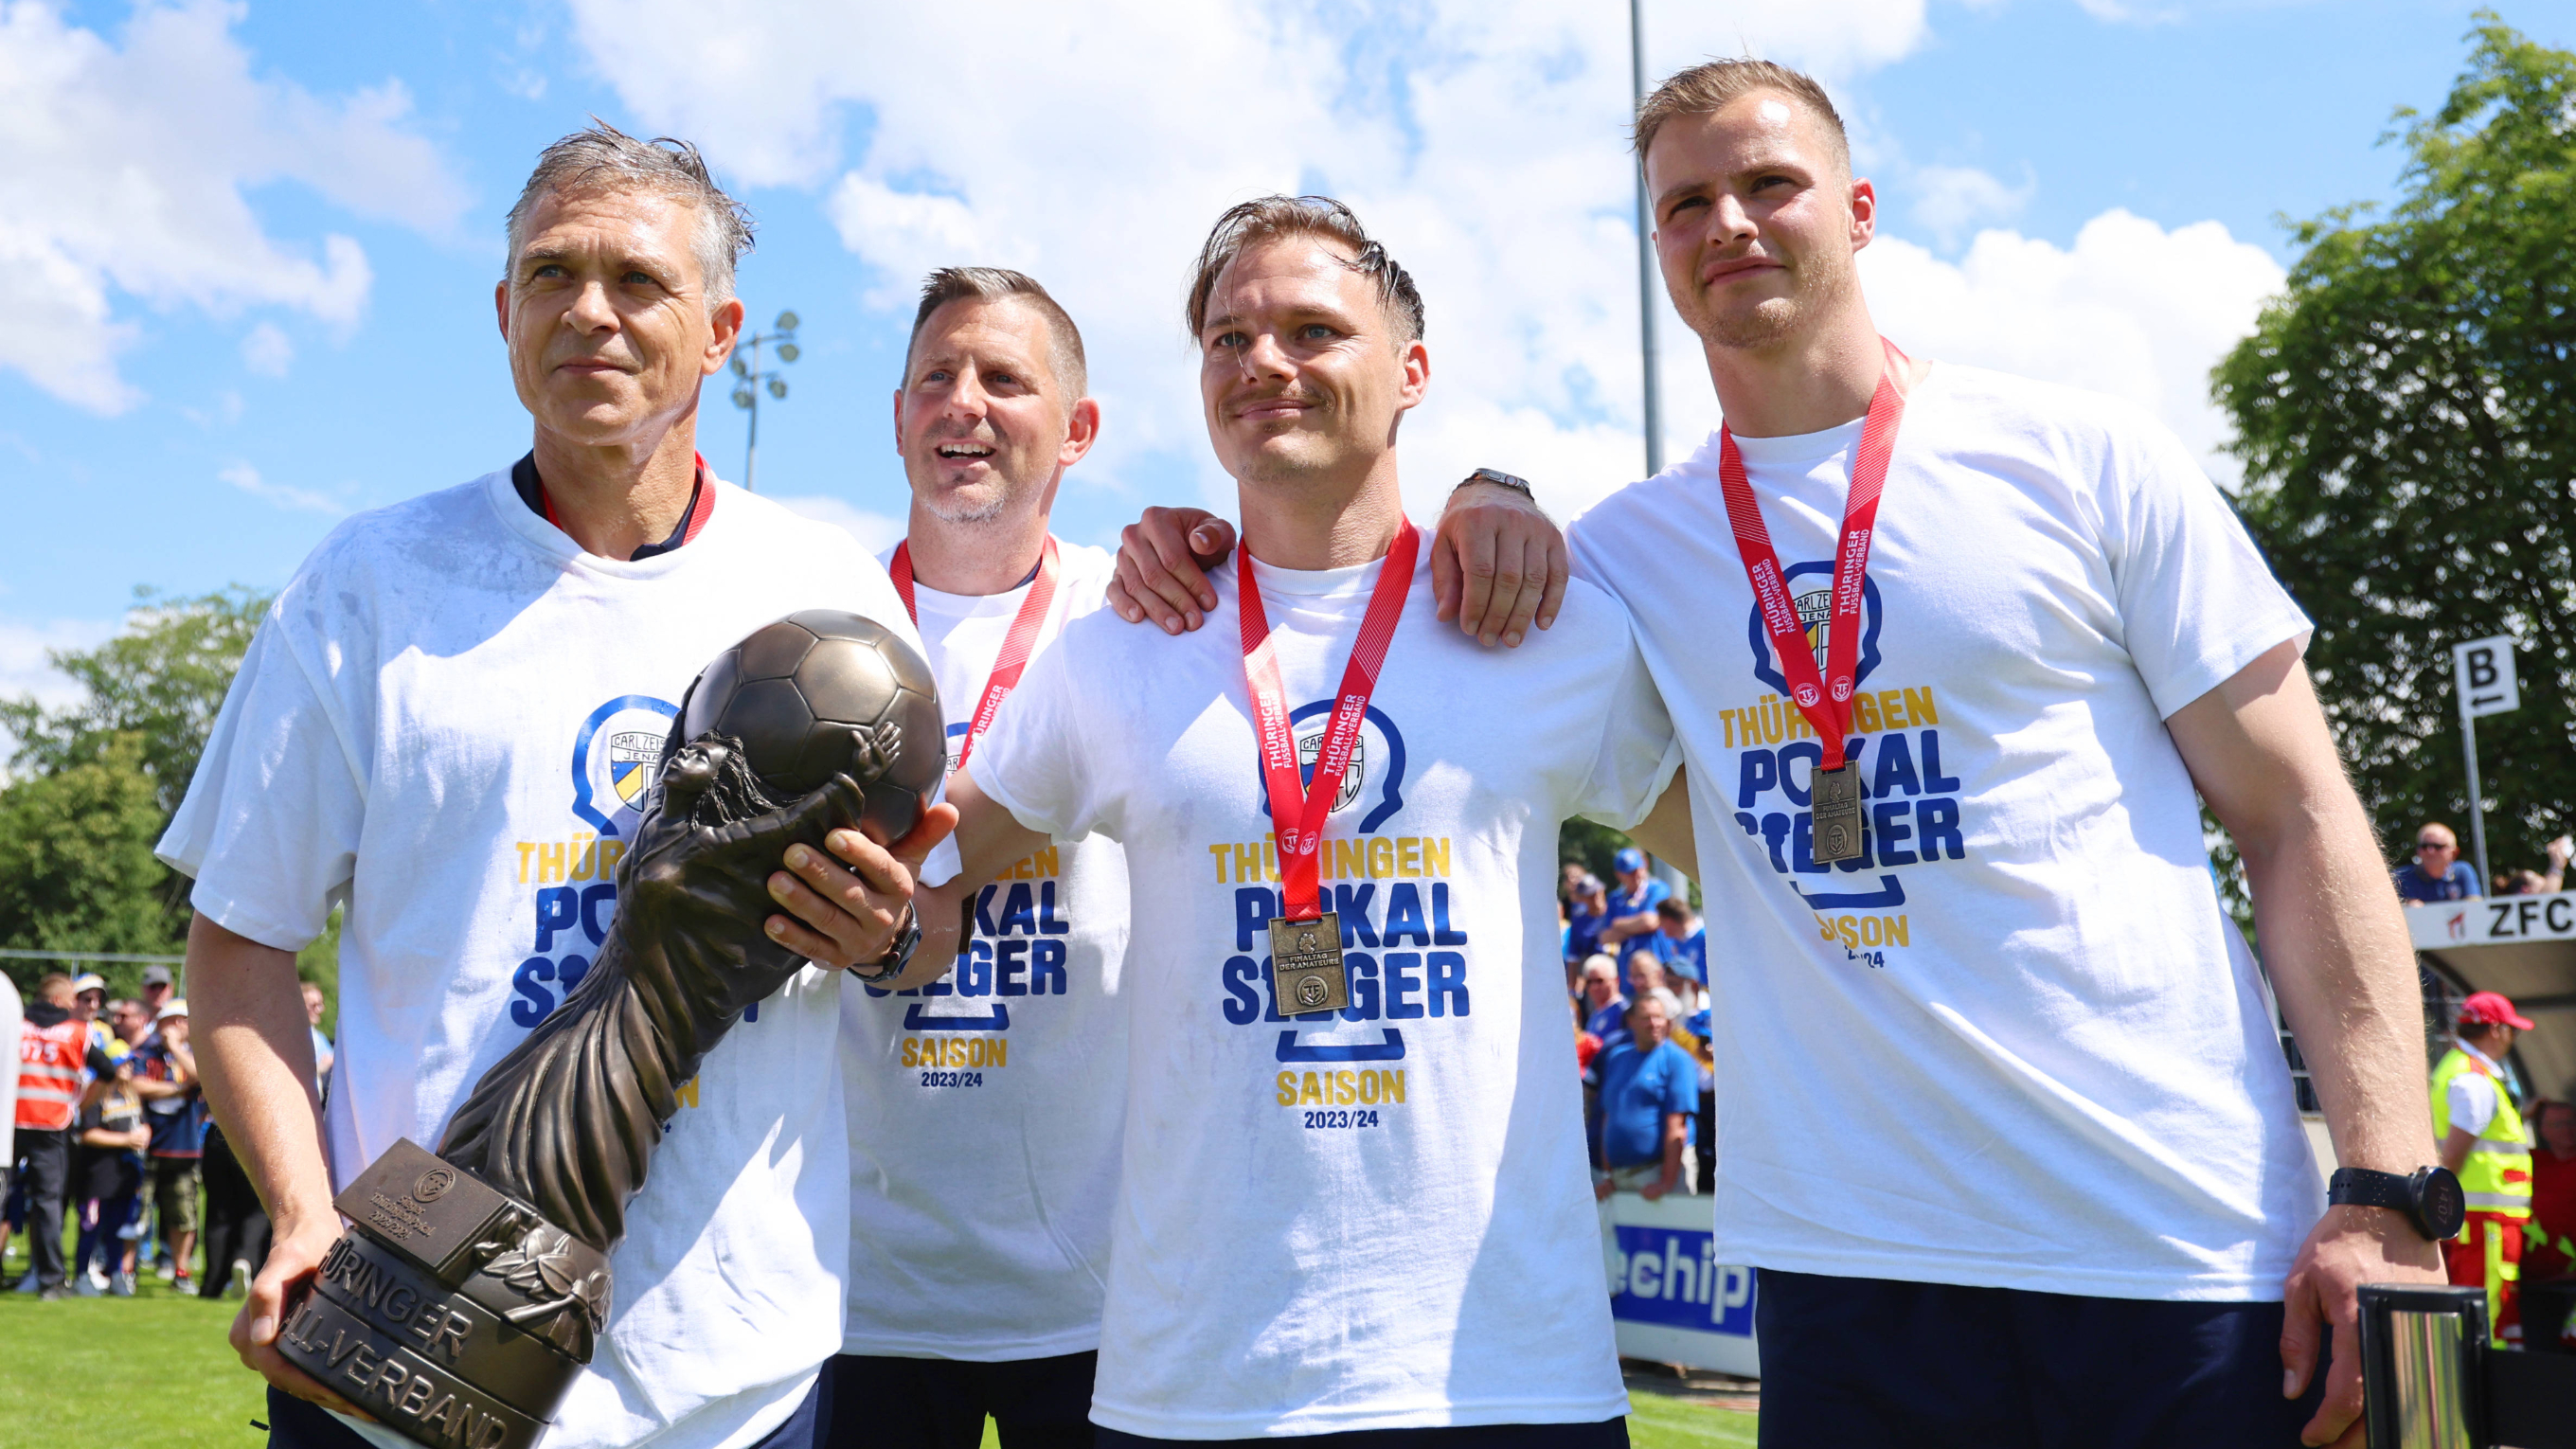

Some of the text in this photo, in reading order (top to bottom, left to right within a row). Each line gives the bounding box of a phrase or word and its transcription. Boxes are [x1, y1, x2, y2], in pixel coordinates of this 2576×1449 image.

[1838, 530, 1860, 616] THÜRINGER
[1850, 528, 1869, 615] FUSSBALL-VERBAND
[1752, 562, 1785, 636] THÜRINGER
[1762, 558, 1796, 633] FUSSBALL-VERBAND
[1795, 595, 1816, 611] ARL
[2468, 648, 2496, 689] B
[614, 734, 641, 749] CARL
[1258, 691, 1283, 770] THÜRINGER
[1323, 694, 1357, 775] THÜRINGER
[1334, 695, 1366, 777] FUSSBALL-VERBAND
[1209, 838, 1450, 884] THÜINGEN
[2489, 898, 2572, 937] ZFC
[1289, 953, 1328, 963] FINALTAG
[1297, 957, 1339, 969] AMATEURE
[1223, 952, 1470, 1025] SGER
[902, 1038, 1007, 1067] SAISON
[921, 1072, 983, 1088] 2023/24
[1277, 1070, 1405, 1106] SAISON
[1305, 1110, 1378, 1129] 2023/24
[317, 1237, 473, 1358] HÜRINGER
